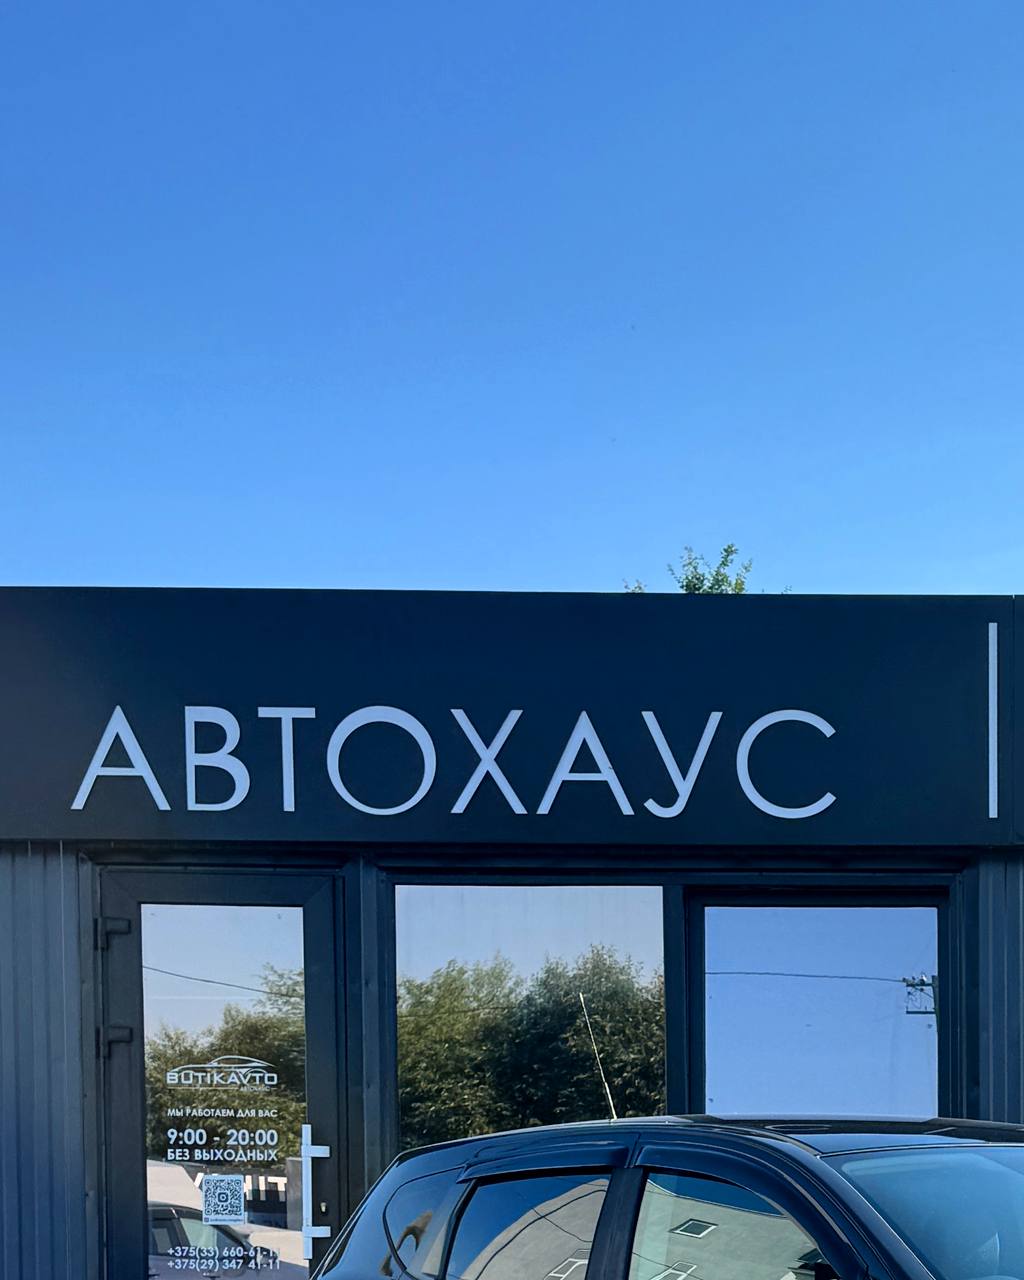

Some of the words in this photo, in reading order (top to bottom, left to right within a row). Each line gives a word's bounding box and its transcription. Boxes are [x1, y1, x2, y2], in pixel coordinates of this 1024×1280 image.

[70, 704, 837, 819] АВТОХАУС
[166, 1072, 278, 1085] BUTIKAVTO
[167, 1108, 183, 1117] МЫ
[185, 1108, 235, 1118] РАБОТАЕМ
[236, 1108, 256, 1118] ДЛЯ
[258, 1109, 278, 1118] ВАС
[167, 1129, 207, 1146] 9:00
[226, 1129, 279, 1146] 20:00
[167, 1148, 189, 1161] БЕЗ
[194, 1148, 278, 1162] ВЫХОДНЫХ
[167, 1246, 220, 1259] +375(33)
[167, 1259, 220, 1272] +375(29)
